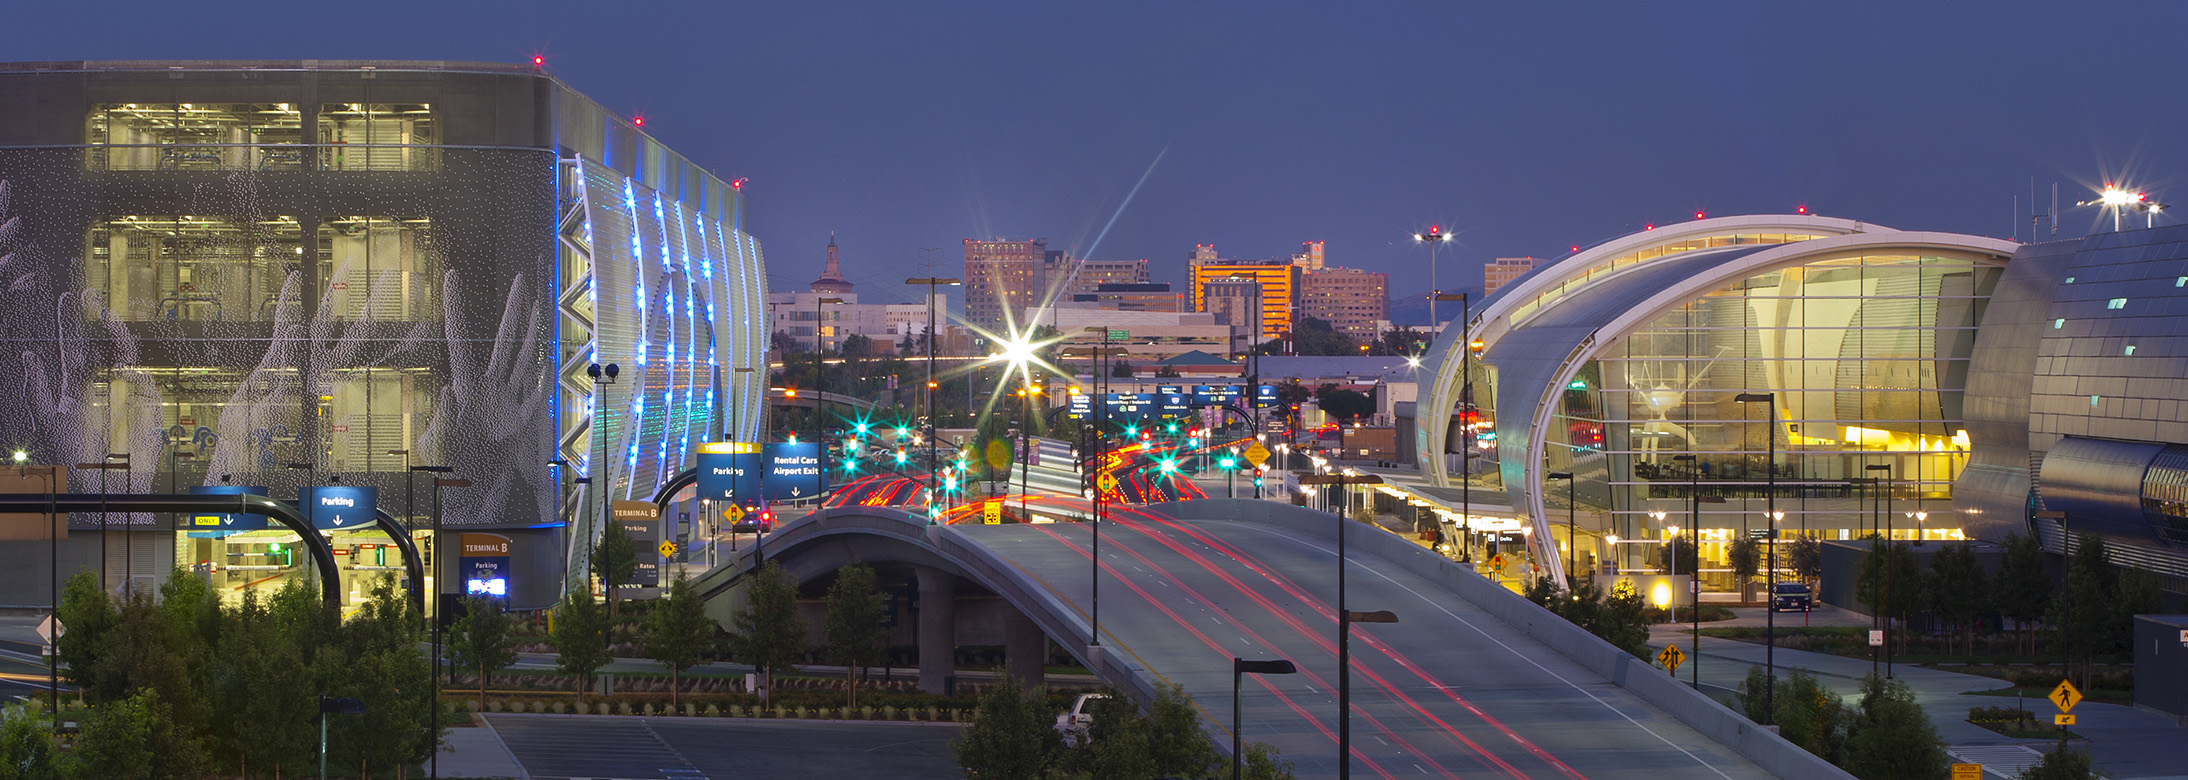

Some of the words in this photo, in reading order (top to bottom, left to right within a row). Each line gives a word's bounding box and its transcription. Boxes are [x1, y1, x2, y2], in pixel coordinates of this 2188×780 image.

[746, 444, 752, 452] B
[774, 456, 799, 464] Rental
[800, 456, 818, 464] Cars
[713, 467, 743, 476] Parking
[774, 467, 802, 476] Airport
[321, 497, 354, 508] Parking
[650, 508, 657, 518] B
[501, 543, 508, 552] B
